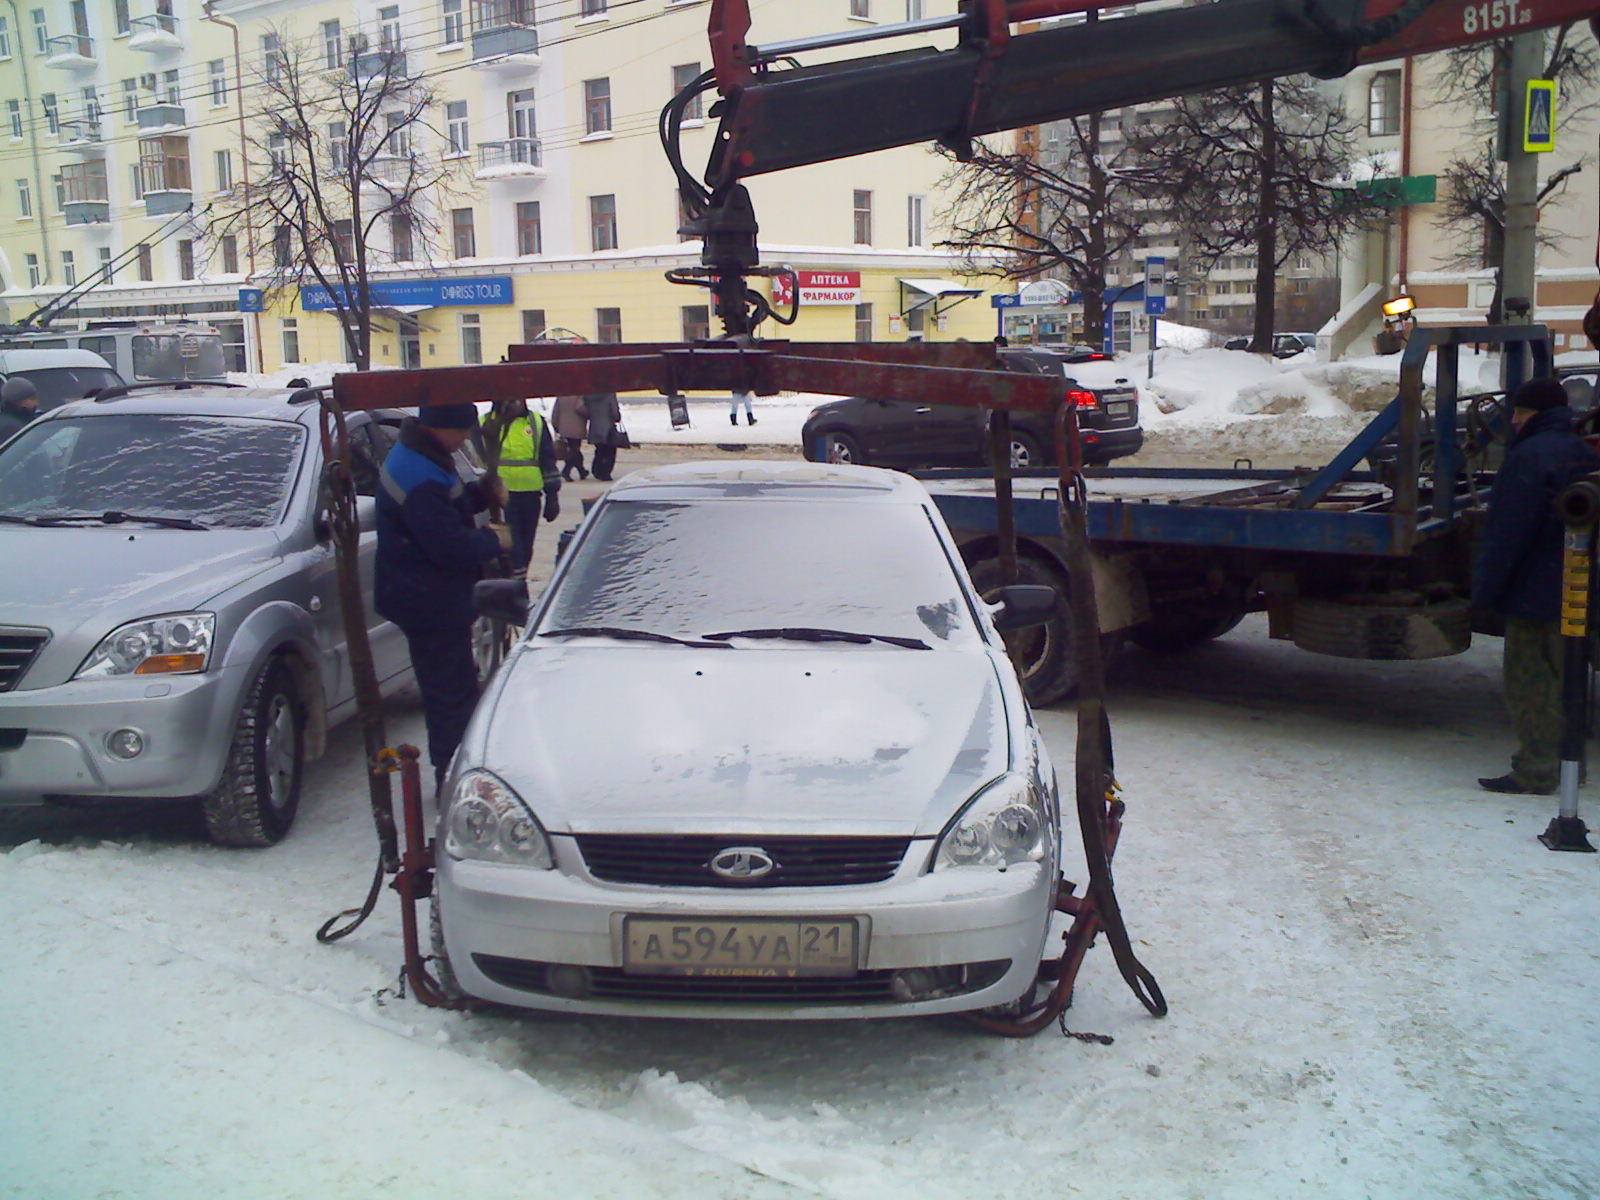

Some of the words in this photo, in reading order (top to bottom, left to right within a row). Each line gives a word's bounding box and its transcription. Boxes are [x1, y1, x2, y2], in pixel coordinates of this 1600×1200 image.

[810, 275, 849, 285] АПТЕКА
[441, 285, 474, 300] DORISS
[475, 284, 502, 298] TOUR
[803, 292, 855, 301] ФАРМАКОР
[804, 926, 841, 953] 21
